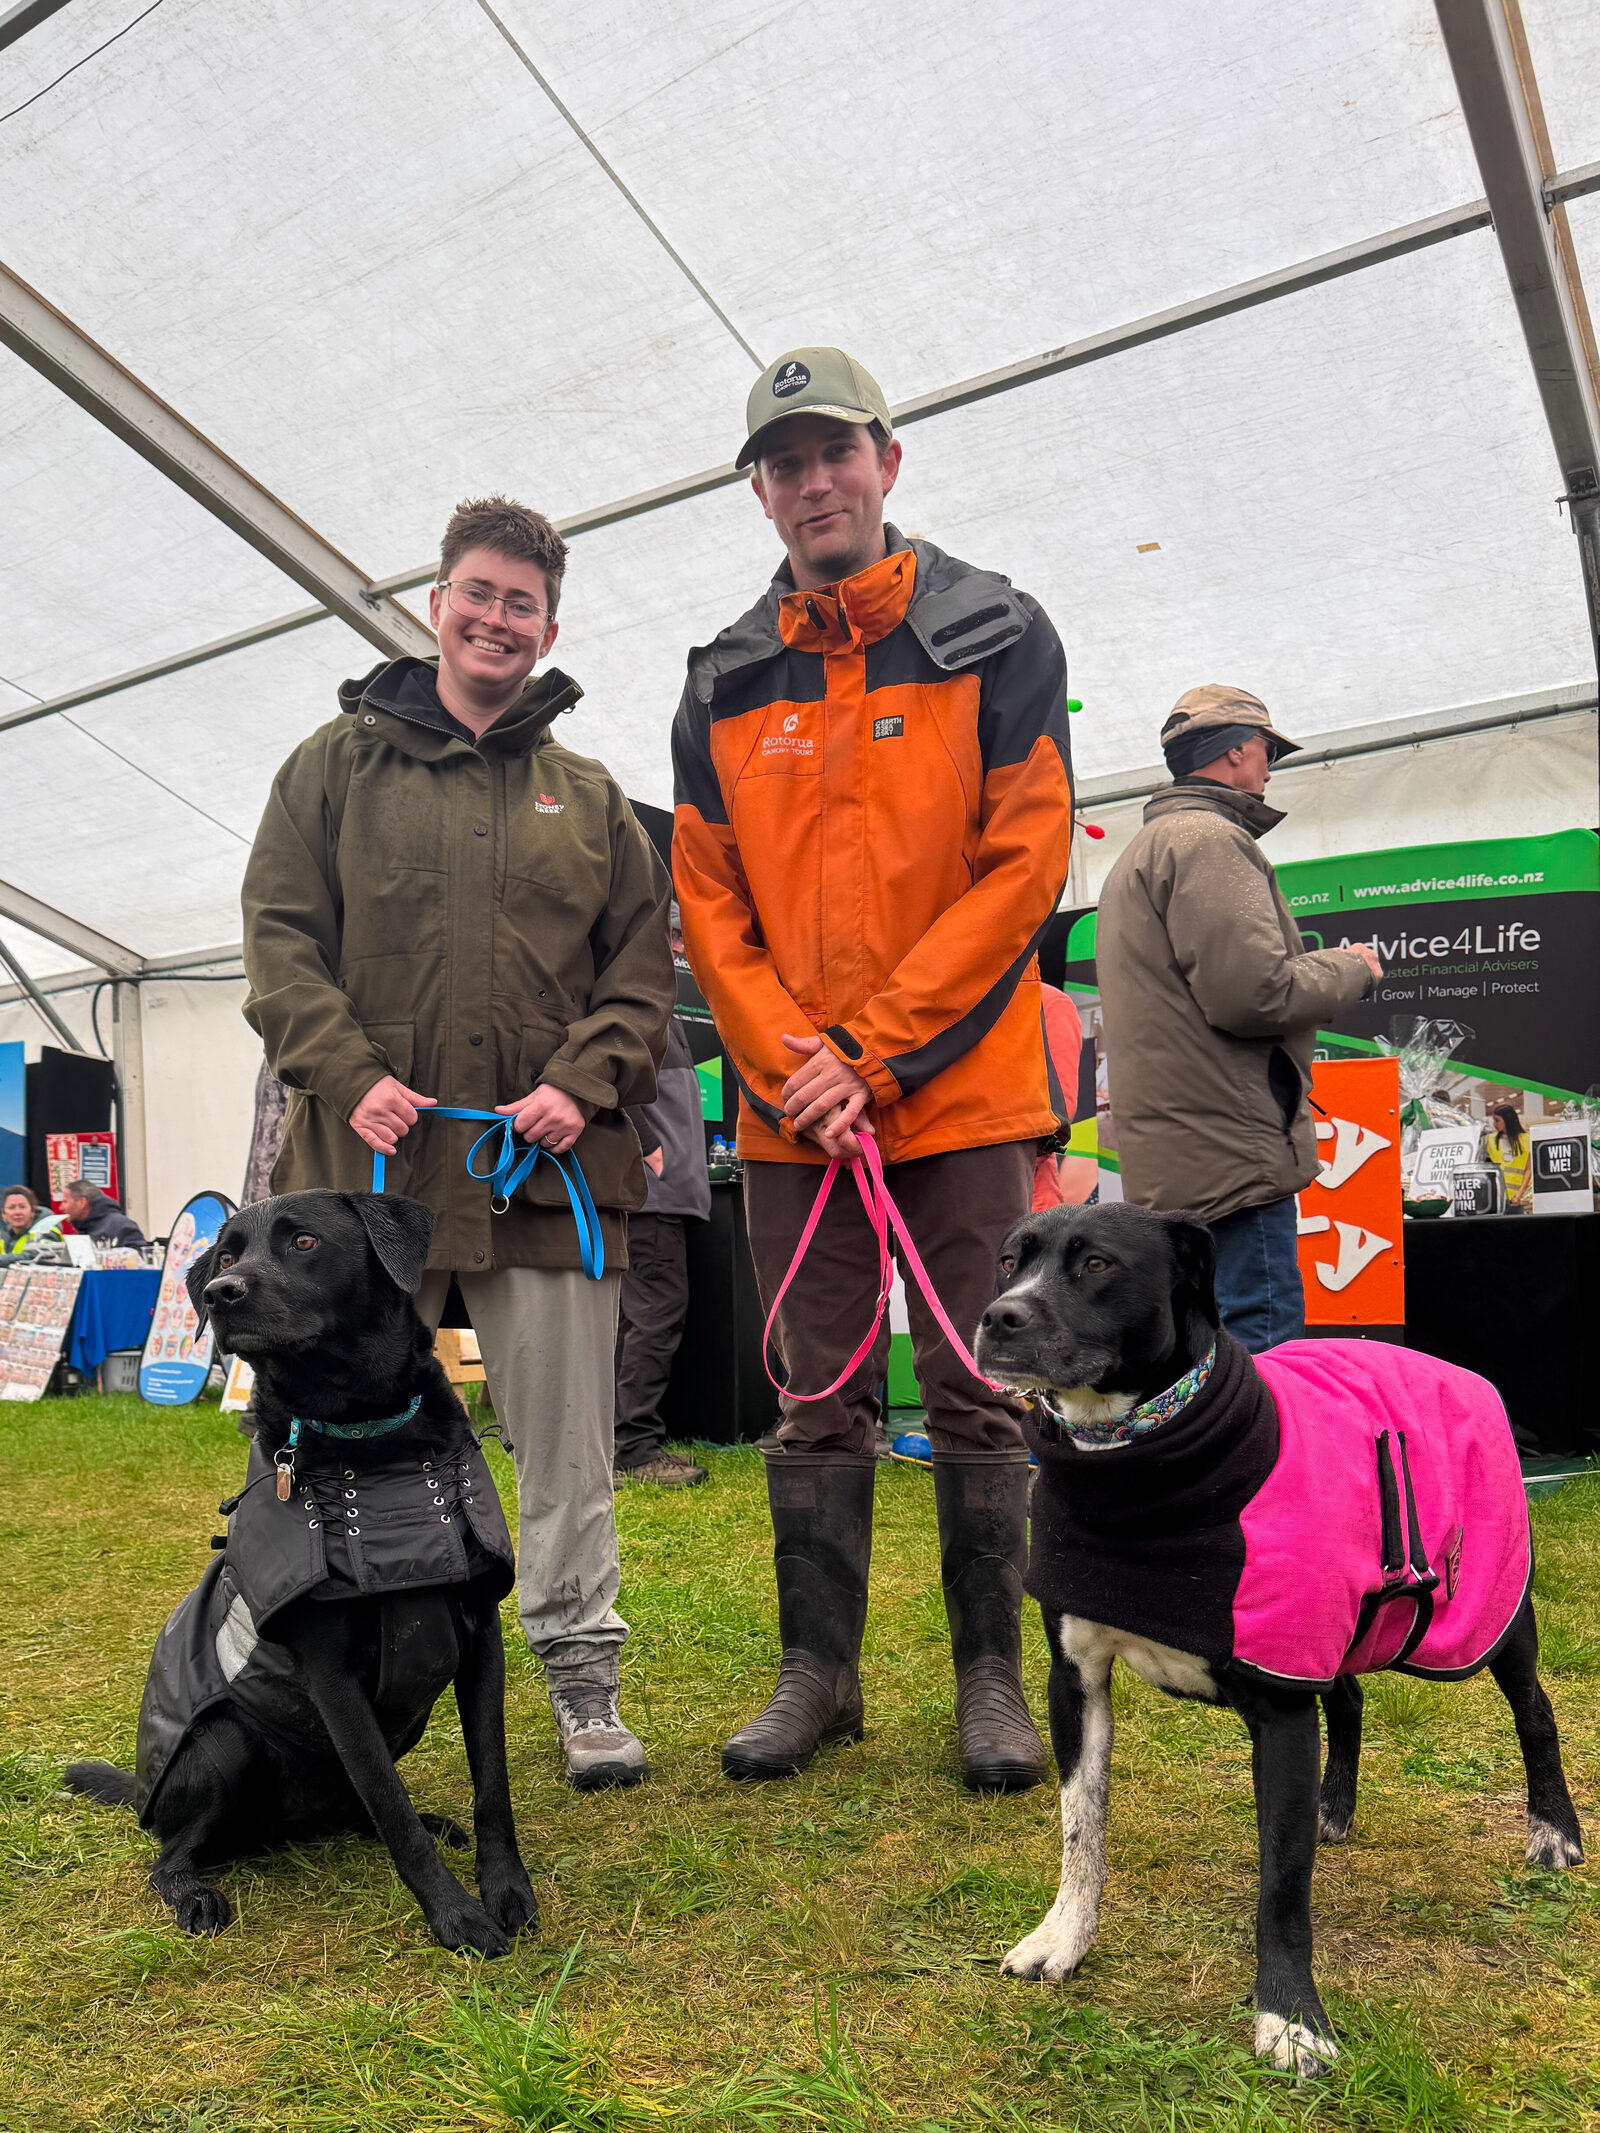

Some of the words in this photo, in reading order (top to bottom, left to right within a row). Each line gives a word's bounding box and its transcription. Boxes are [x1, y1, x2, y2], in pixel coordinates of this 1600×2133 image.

[774, 375, 807, 389] Rotorua
[762, 736, 814, 748] Rotorua
[761, 747, 789, 756] CANOPY
[791, 748, 814, 756] TOURS
[1288, 892, 1330, 907] .co.nz
[1353, 871, 1545, 899] www.advice4life.co.nz
[1383, 964, 1419, 980] usted
[1421, 961, 1479, 976] Financial
[1481, 958, 1540, 973] Advisers
[1381, 988, 1415, 1001] Grow
[1427, 984, 1478, 1000] Manage
[1491, 981, 1540, 994] Protect
[1429, 1145, 1464, 1159] ENTER
[1547, 1144, 1572, 1160] WIN
[1432, 1157, 1454, 1170] AND
[1549, 1158, 1572, 1173] ME!
[1454, 1178, 1481, 1190] NTER
[1453, 1189, 1475, 1201] AND
